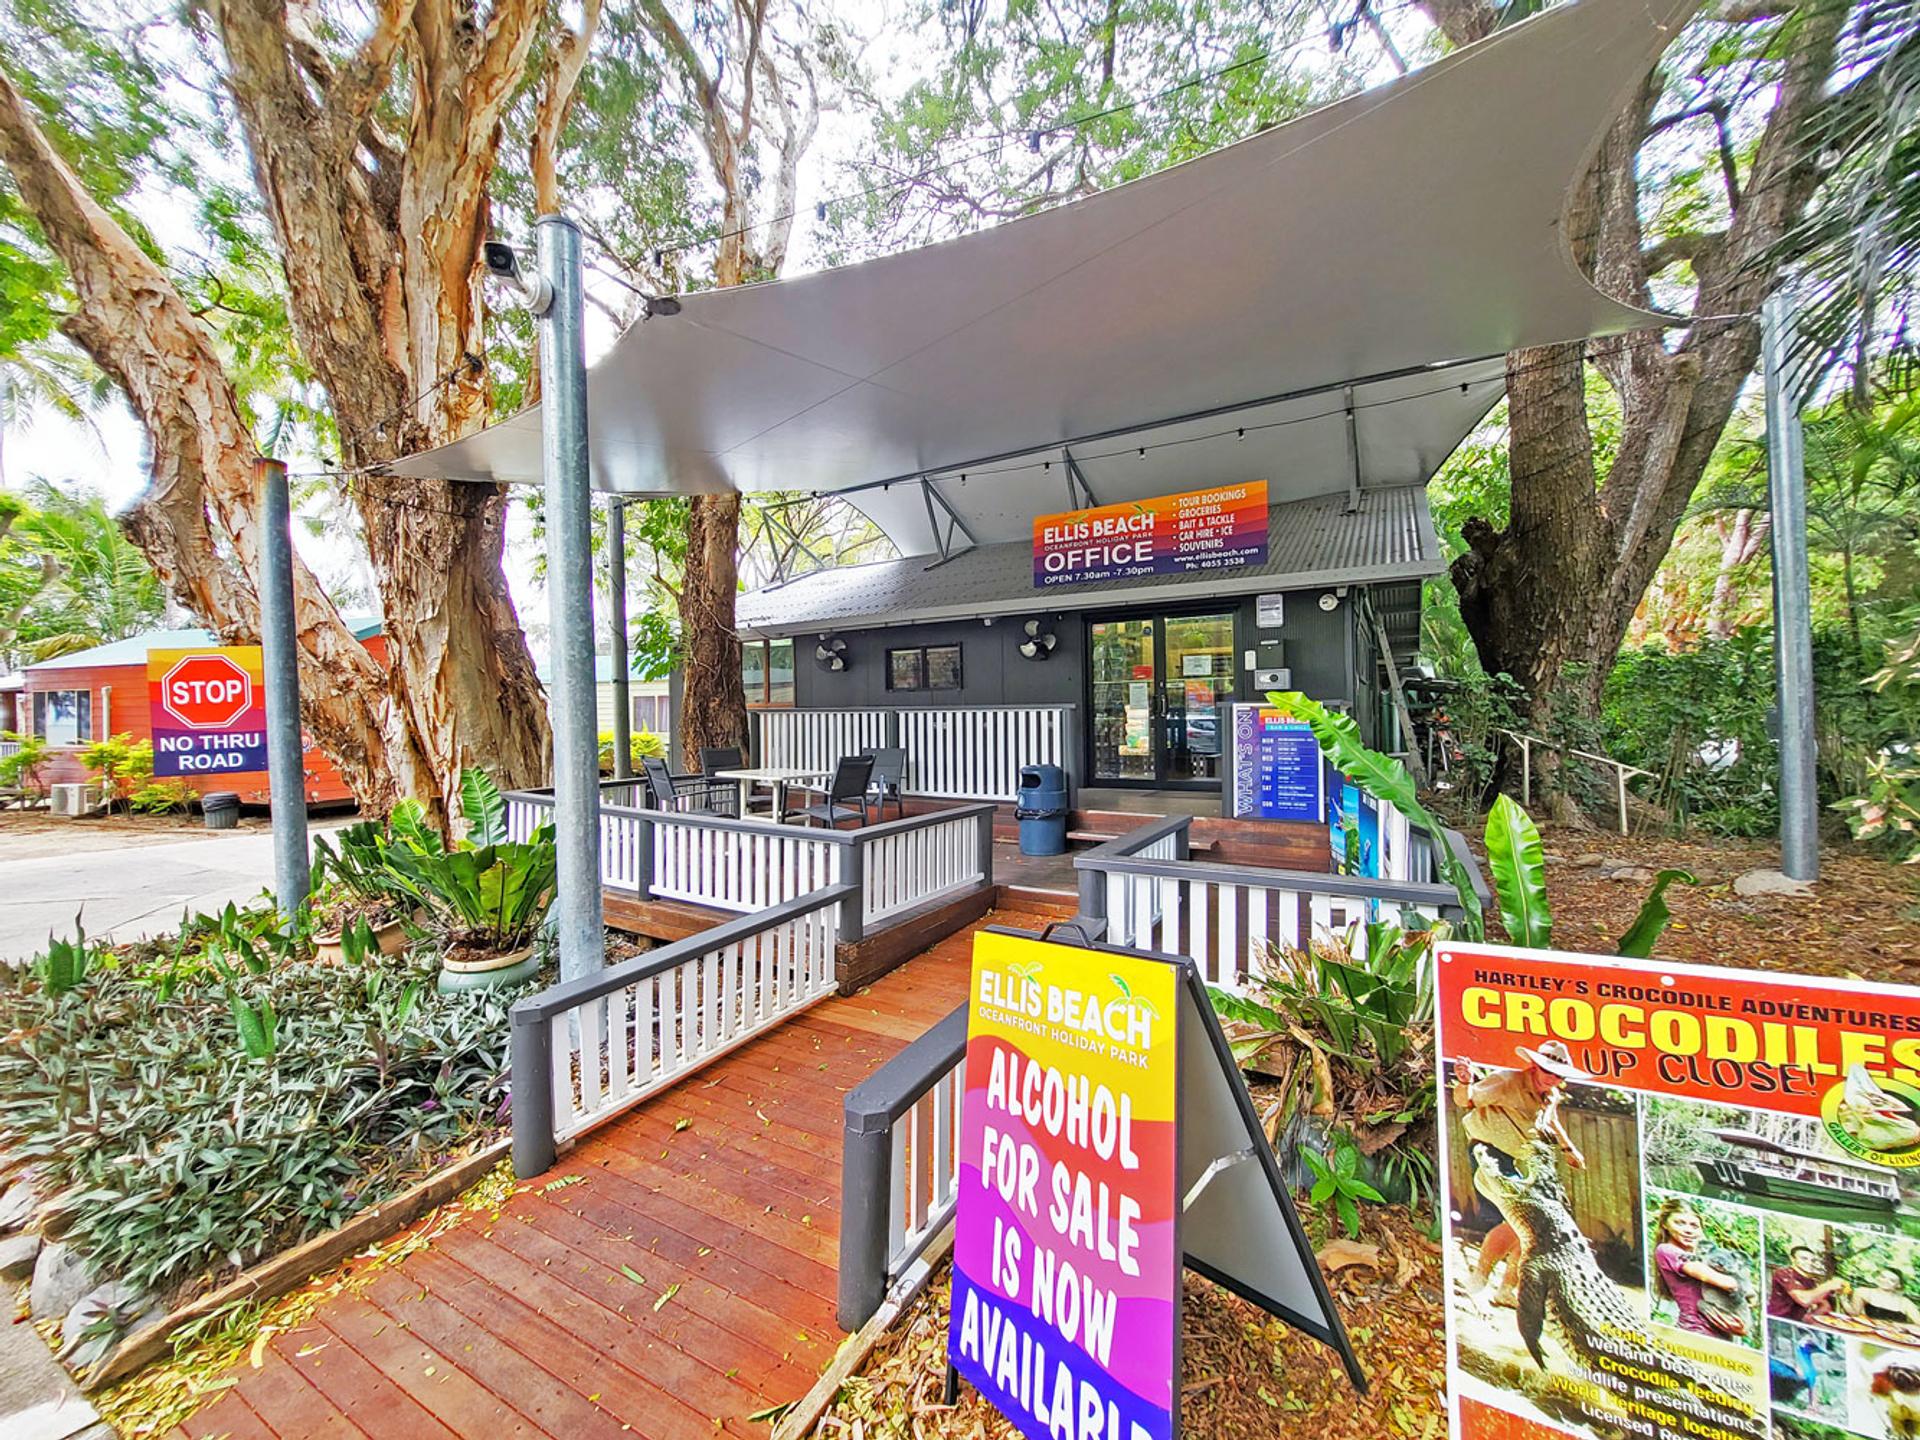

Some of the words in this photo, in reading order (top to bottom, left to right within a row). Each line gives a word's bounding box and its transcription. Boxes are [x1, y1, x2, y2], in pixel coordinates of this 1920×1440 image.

[1179, 496, 1200, 507] TOUR
[1201, 488, 1247, 504] BOOKINGS
[1179, 504, 1222, 519] GROCERIES
[1044, 522, 1089, 544] ELLIS
[1093, 512, 1155, 537] BEACH
[1179, 518, 1197, 530] BAIT
[1198, 518, 1205, 527] &
[1206, 513, 1235, 526] TACKLE
[1179, 530, 1194, 541] CAR
[1196, 528, 1214, 539] HIRE
[1221, 525, 1233, 536] ICE
[1044, 540, 1093, 552] OCEANFRONT
[1096, 535, 1129, 544] HOLIDAY
[1132, 531, 1154, 539] PARK
[1044, 540, 1154, 572] OFFICE
[1174, 547, 1259, 562] www.ellisbeach.com
[1179, 538, 1224, 552] SOUVENIRS
[1044, 574, 1072, 584] OPEN
[1075, 571, 1110, 580] 7.30am
[172, 679, 242, 705] STOP
[160, 736, 193, 752] NO
[198, 733, 260, 750] THRU
[178, 752, 243, 770] ROAD
[979, 969, 1042, 1017] ELLIS
[1047, 985, 1151, 1050] BEACH
[1474, 969, 1589, 995] HARTLEY'S
[1597, 983, 1732, 1012] CROCODILE
[1742, 998, 1920, 1032] ADVENTURES
[979, 1006, 1048, 1037] OCEANFRONT
[1051, 1029, 1105, 1056] HOLIDAY
[1110, 1046, 1149, 1070] PARK
[1583, 1048, 1637, 1079] UP
[1656, 1052, 1818, 1097] CLOSE!
[986, 1046, 1139, 1170] ALCOHOL
[1828, 1121, 1868, 1157] GALLERY
[981, 1125, 1040, 1218] FOR
[1049, 1160, 1141, 1278] SALE
[992, 1216, 1022, 1298] IS
[1031, 1244, 1118, 1368] NOW
[1600, 1321, 1646, 1346] Koala
[1586, 1333, 1655, 1366] Wetland
[1660, 1356, 1702, 1380] boat
[1551, 1375, 1599, 1400] World
[1604, 1391, 1677, 1427] Heritage
[1568, 1362, 1628, 1393] Wildlife
[1634, 1385, 1755, 1432] presentations
[1687, 1379, 1754, 1418] feeding
[1580, 1401, 1654, 1437] Licensed
